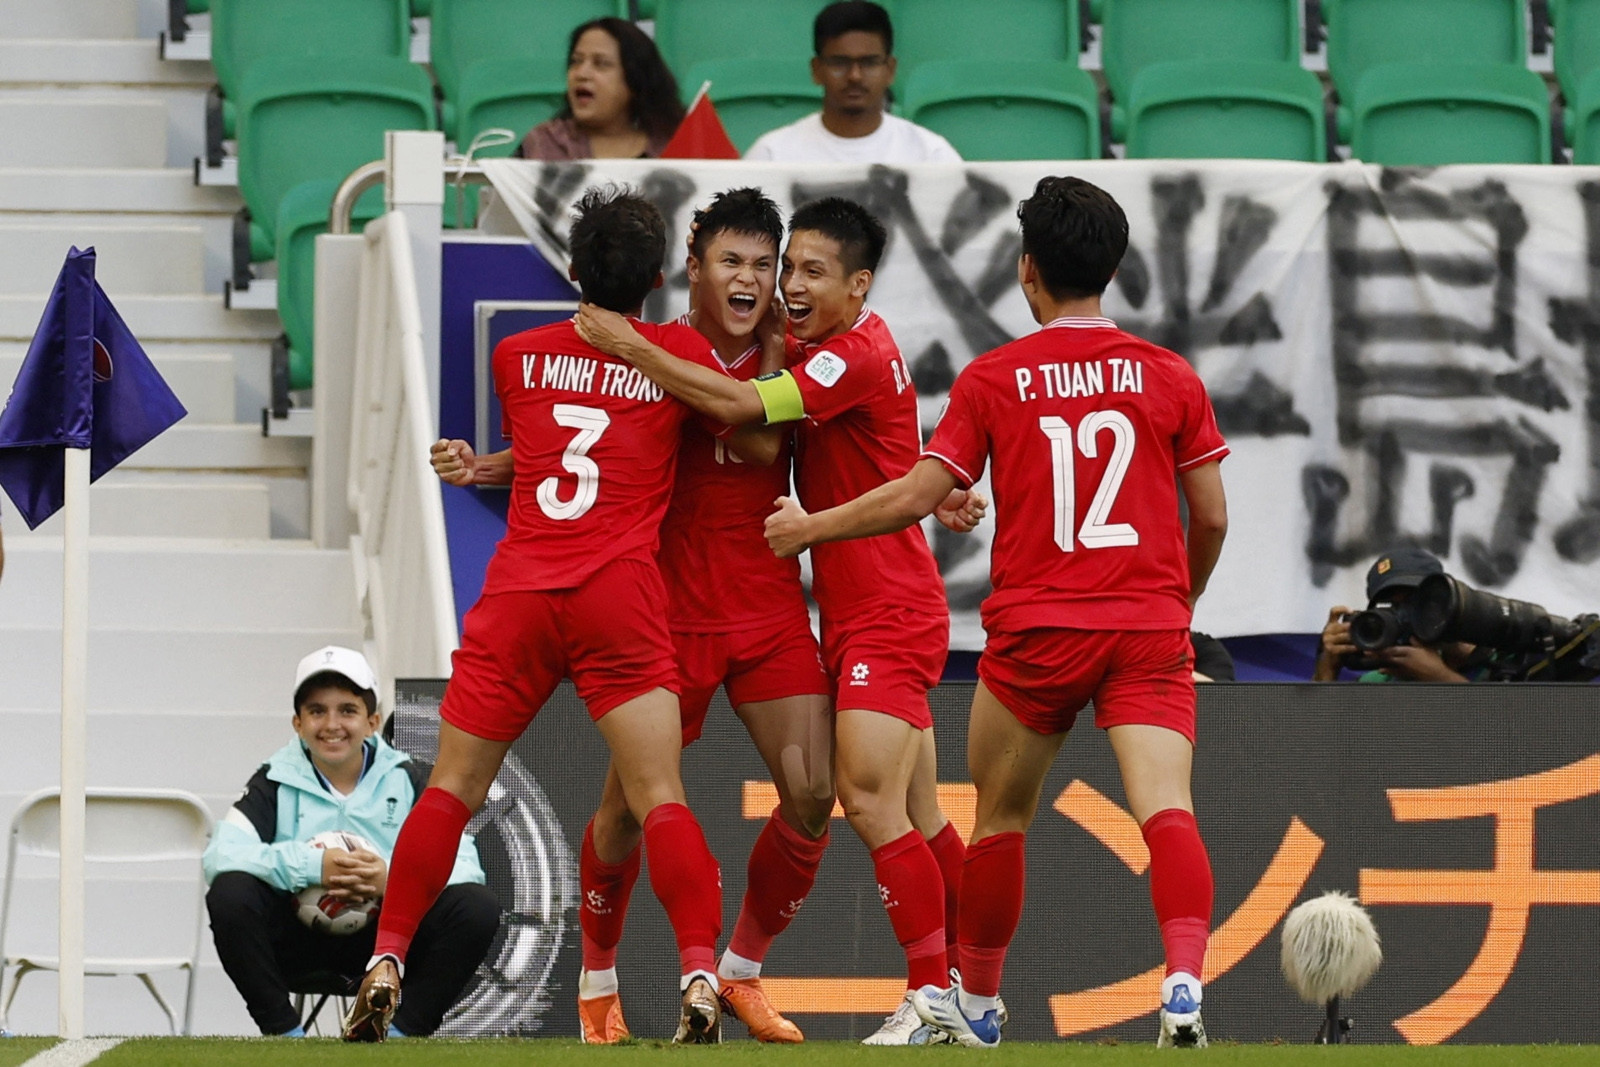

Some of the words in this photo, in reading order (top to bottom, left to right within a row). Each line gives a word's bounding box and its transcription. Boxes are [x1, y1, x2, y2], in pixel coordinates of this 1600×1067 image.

[522, 354, 536, 389] V.
[541, 354, 598, 394] MINH
[1015, 367, 1037, 402] P.
[1038, 360, 1105, 398] TUAN
[1107, 358, 1143, 394] TAI
[536, 404, 611, 520] 3
[1038, 409, 1139, 553] 12
